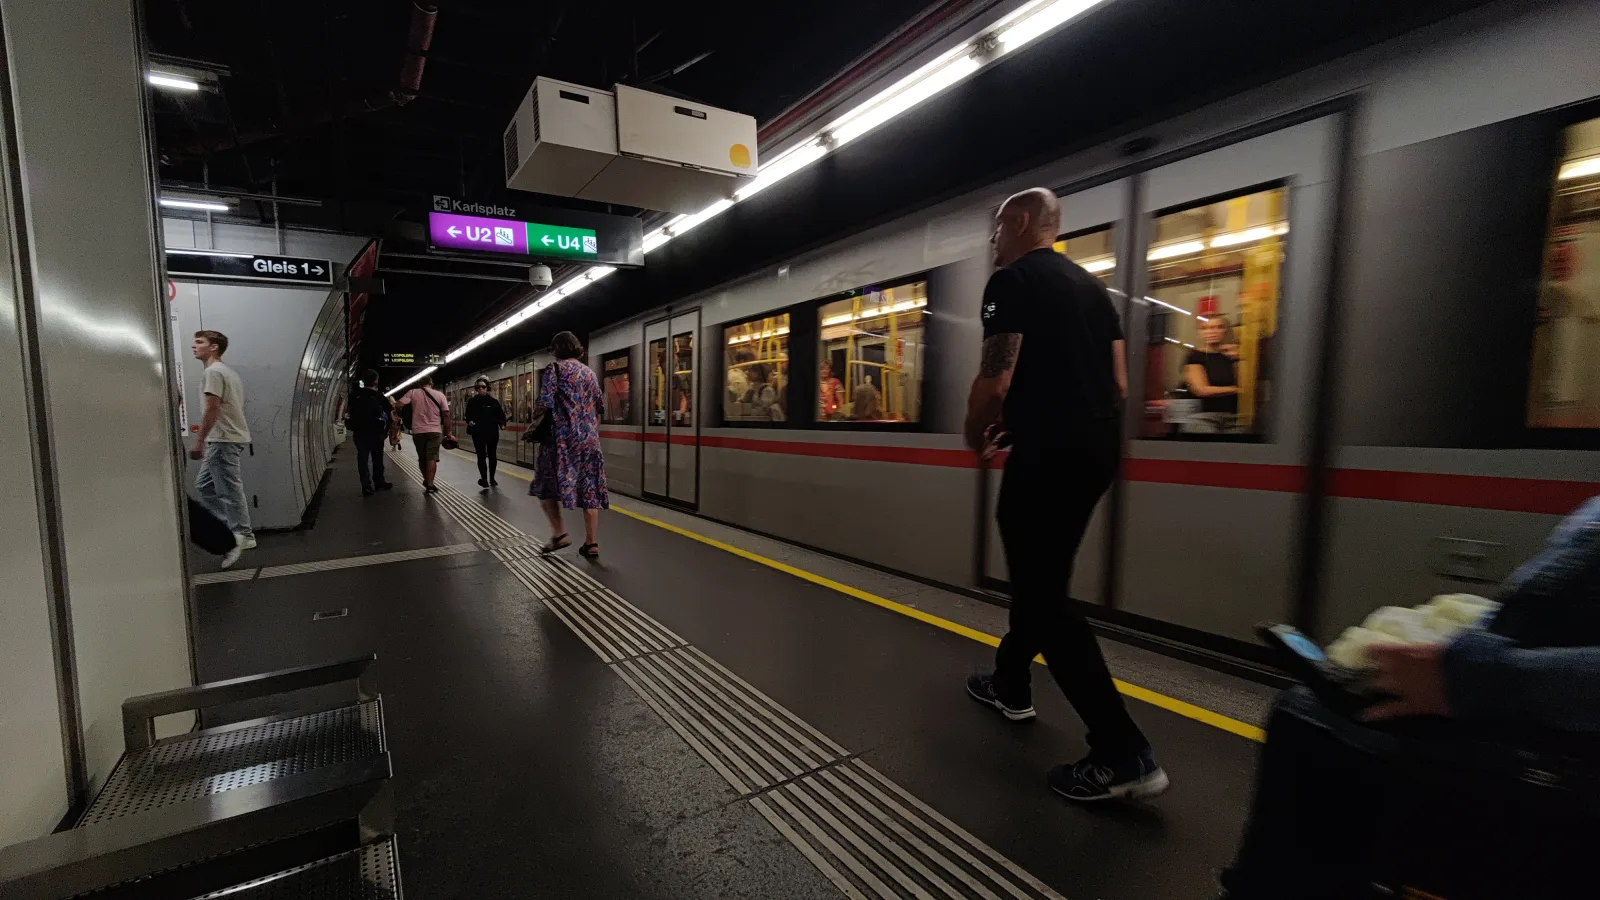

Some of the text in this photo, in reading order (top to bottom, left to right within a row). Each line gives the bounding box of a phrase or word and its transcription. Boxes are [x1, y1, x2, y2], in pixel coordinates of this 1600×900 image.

[452, 199, 516, 217] Karlsplatz
[466, 225, 492, 242] U2
[557, 235, 581, 250] U4
[253, 259, 309, 275] Gleis 1
